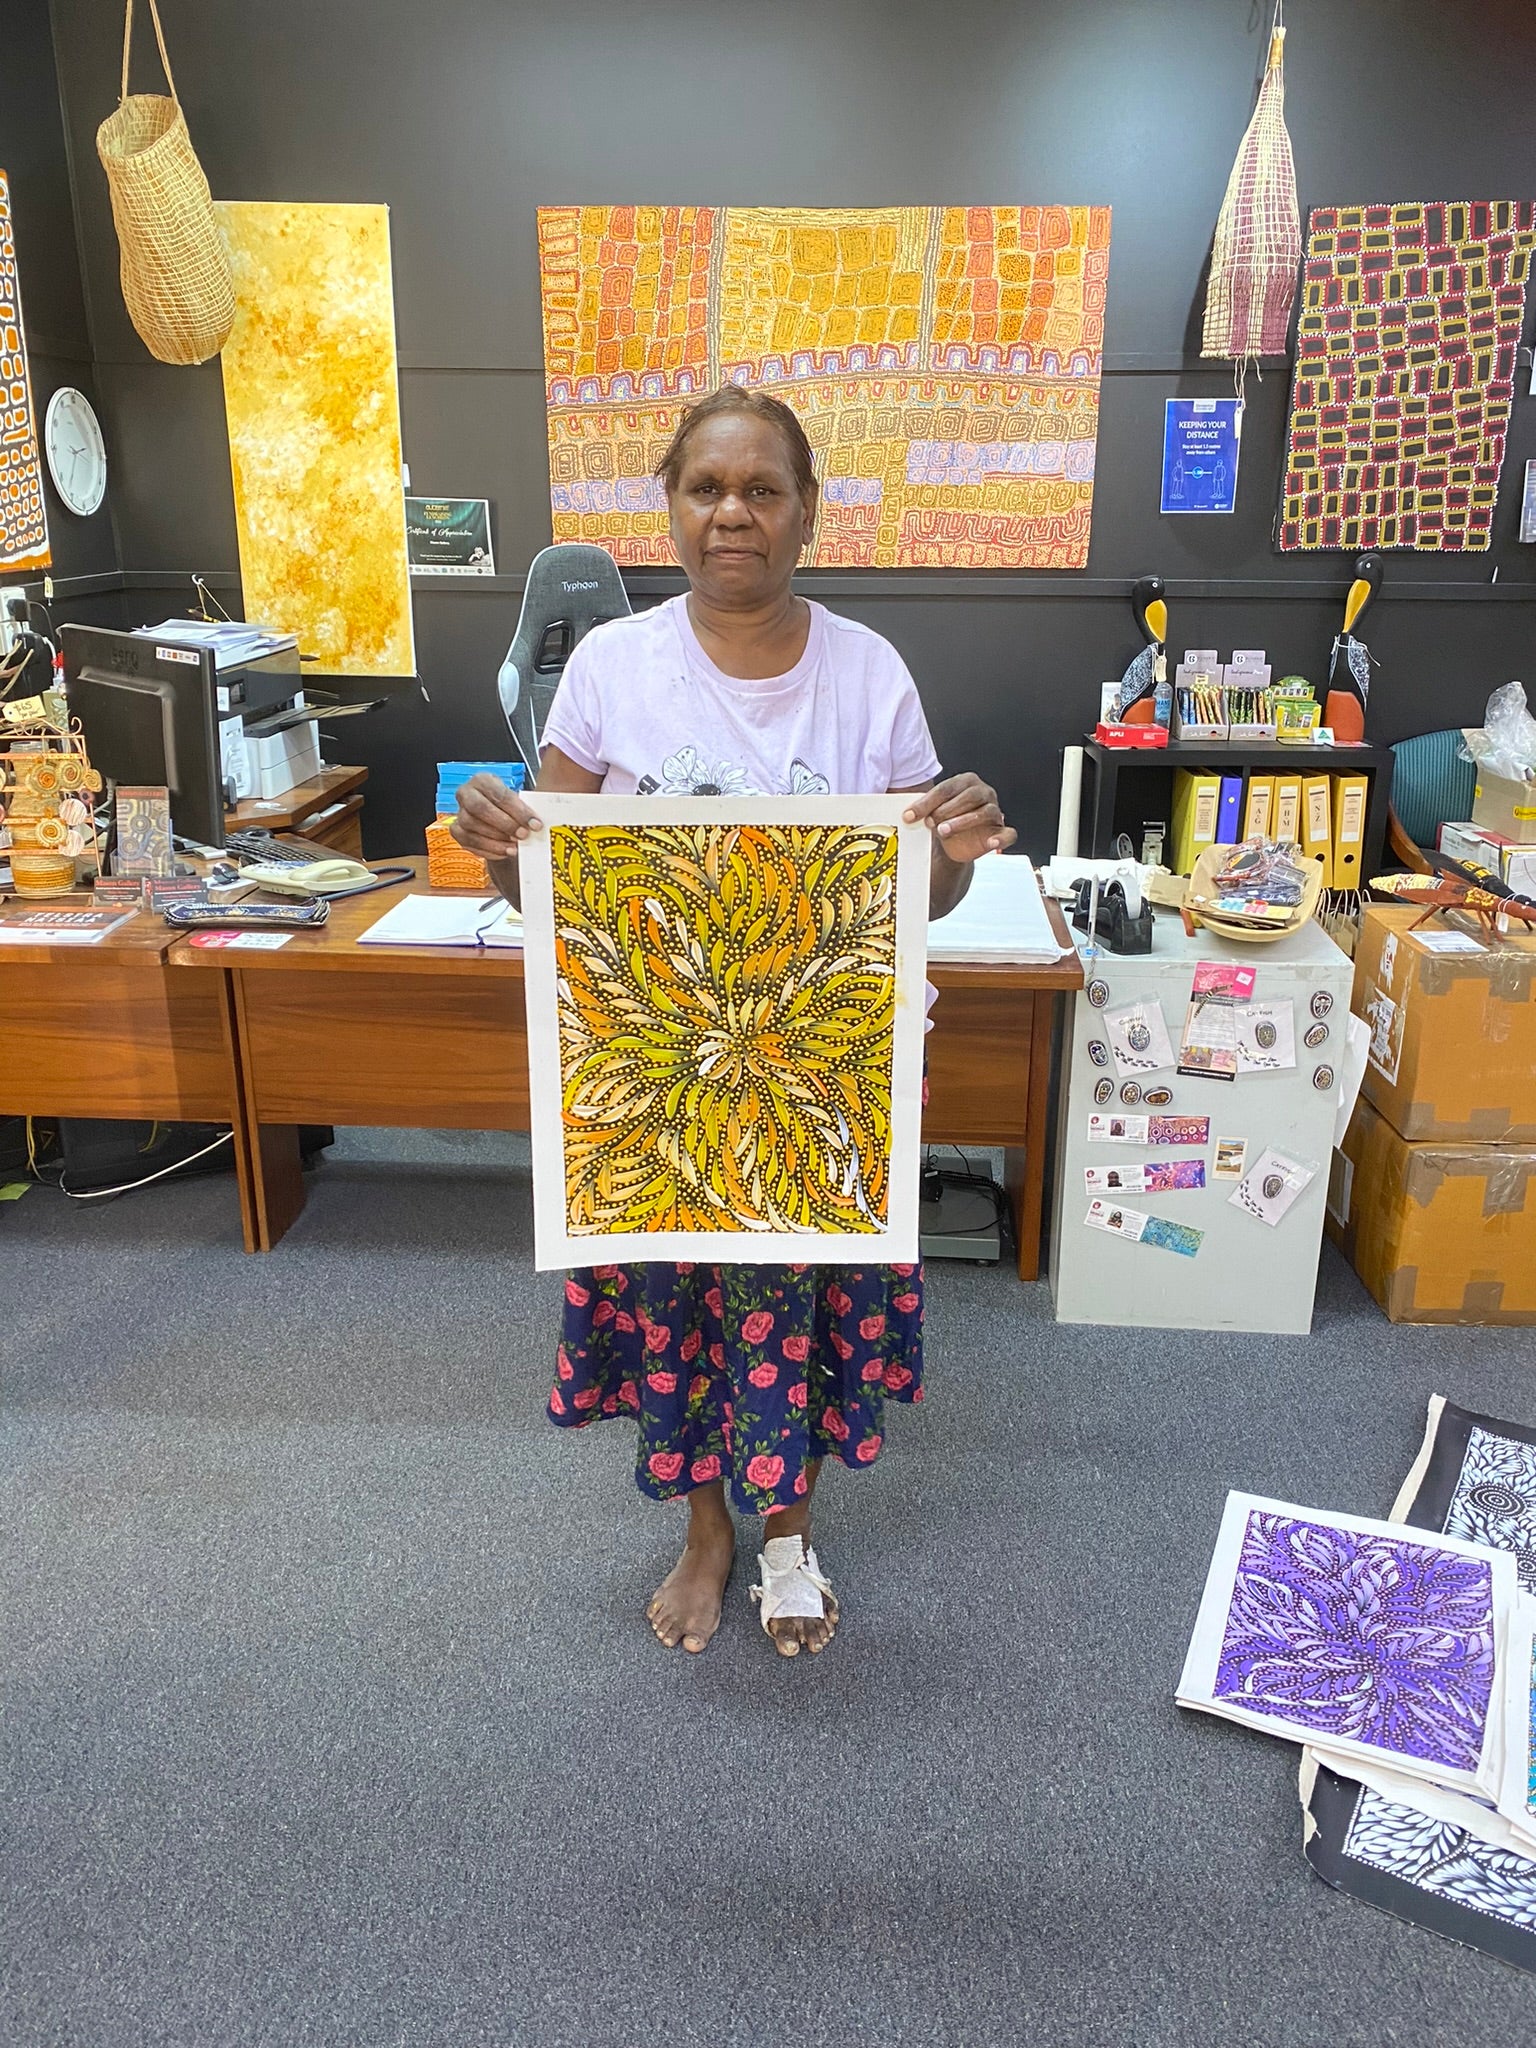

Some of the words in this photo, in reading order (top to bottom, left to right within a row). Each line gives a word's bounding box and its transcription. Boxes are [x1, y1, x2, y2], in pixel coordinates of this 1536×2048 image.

[1178, 421, 1207, 429] KEEPING
[1207, 421, 1227, 429] YOUR
[1186, 431, 1219, 439] DISTANCE
[561, 580, 599, 592] Typhoon
